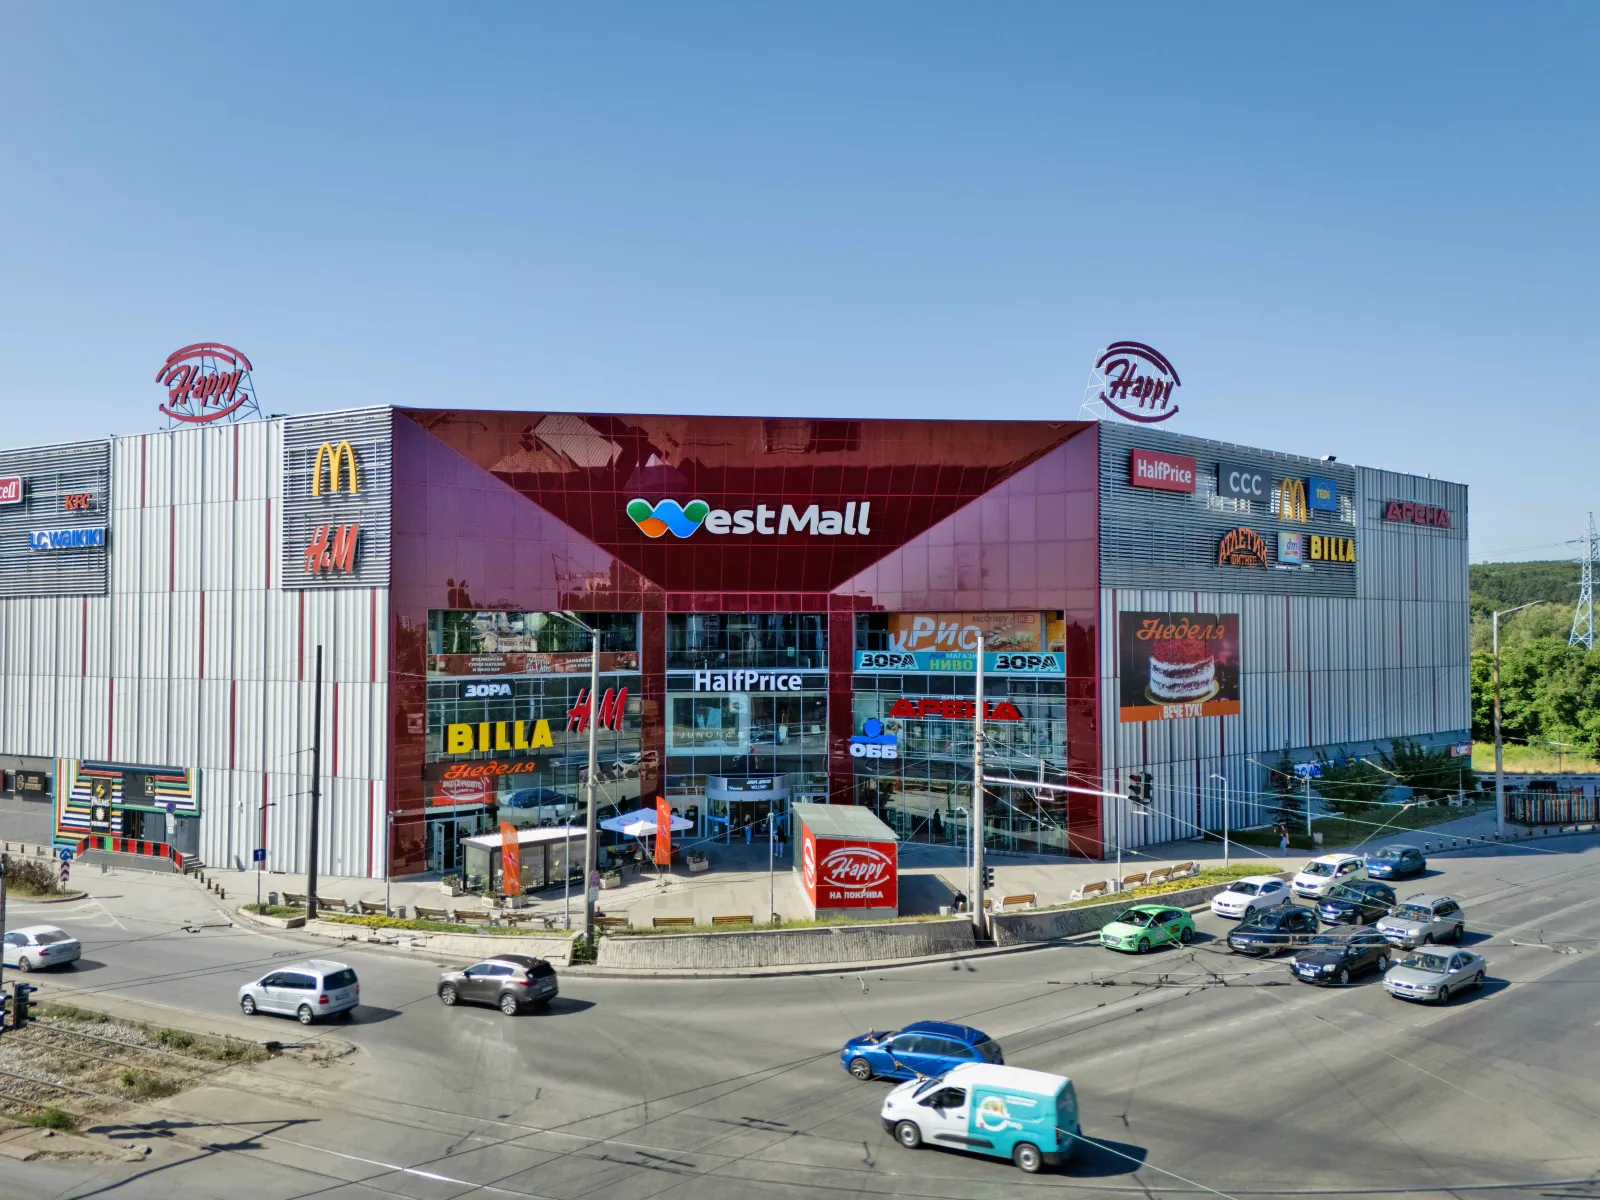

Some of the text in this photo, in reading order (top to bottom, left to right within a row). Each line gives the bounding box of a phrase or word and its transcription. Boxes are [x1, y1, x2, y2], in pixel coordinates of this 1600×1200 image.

[164, 364, 243, 407] Happy
[1104, 358, 1174, 409] Happy
[1137, 459, 1192, 484] HalfPrice
[1229, 471, 1262, 495] CCC
[64, 493, 92, 510] KFC
[304, 523, 360, 575] H&M
[1218, 527, 1269, 569] АТЛЕТИК
[1286, 537, 1299, 550] dm
[1310, 535, 1356, 563] BILLA
[972, 614, 1008, 625] McCrispy
[1136, 617, 1225, 641] Неделя
[860, 652, 917, 670] ЗОРА
[930, 659, 973, 671] НИВО
[995, 654, 1059, 670] ЗОРА
[465, 684, 512, 697] ЗОРА
[695, 670, 802, 692] HalfPrice
[566, 687, 628, 733] HM
[888, 698, 1022, 721] АРЕНА
[1163, 703, 1203, 720] ВЕЧЕ ТУК!
[447, 719, 553, 754] BILLA
[849, 743, 898, 759] ОББ
[444, 760, 536, 779] Неделя
[827, 857, 887, 881] Happy
[829, 891, 884, 899] НА ПОКРИВА
